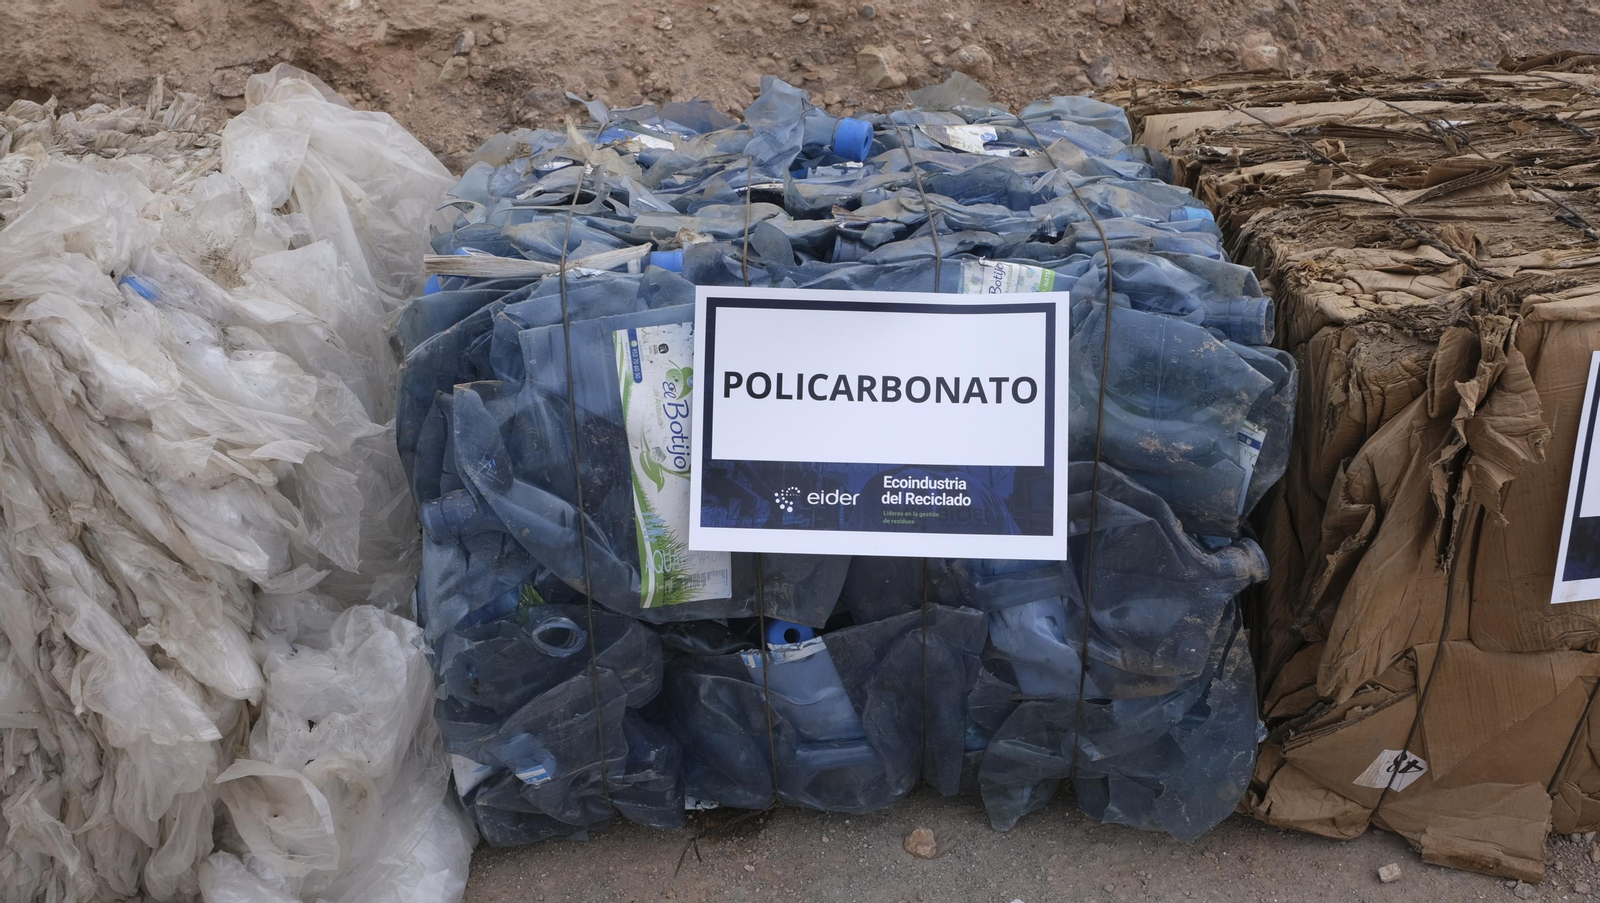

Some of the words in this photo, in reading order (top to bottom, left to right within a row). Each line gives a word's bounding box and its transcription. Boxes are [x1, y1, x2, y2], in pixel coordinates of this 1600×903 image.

[631, 348, 639, 358] 952
[662, 381, 677, 399] El
[723, 371, 1038, 404] POLICARBONATO
[663, 399, 690, 469] Botijo
[883, 475, 967, 490] Ecoindustria
[806, 488, 860, 506] eider
[881, 491, 902, 505] del
[905, 492, 972, 507] Reciclado
